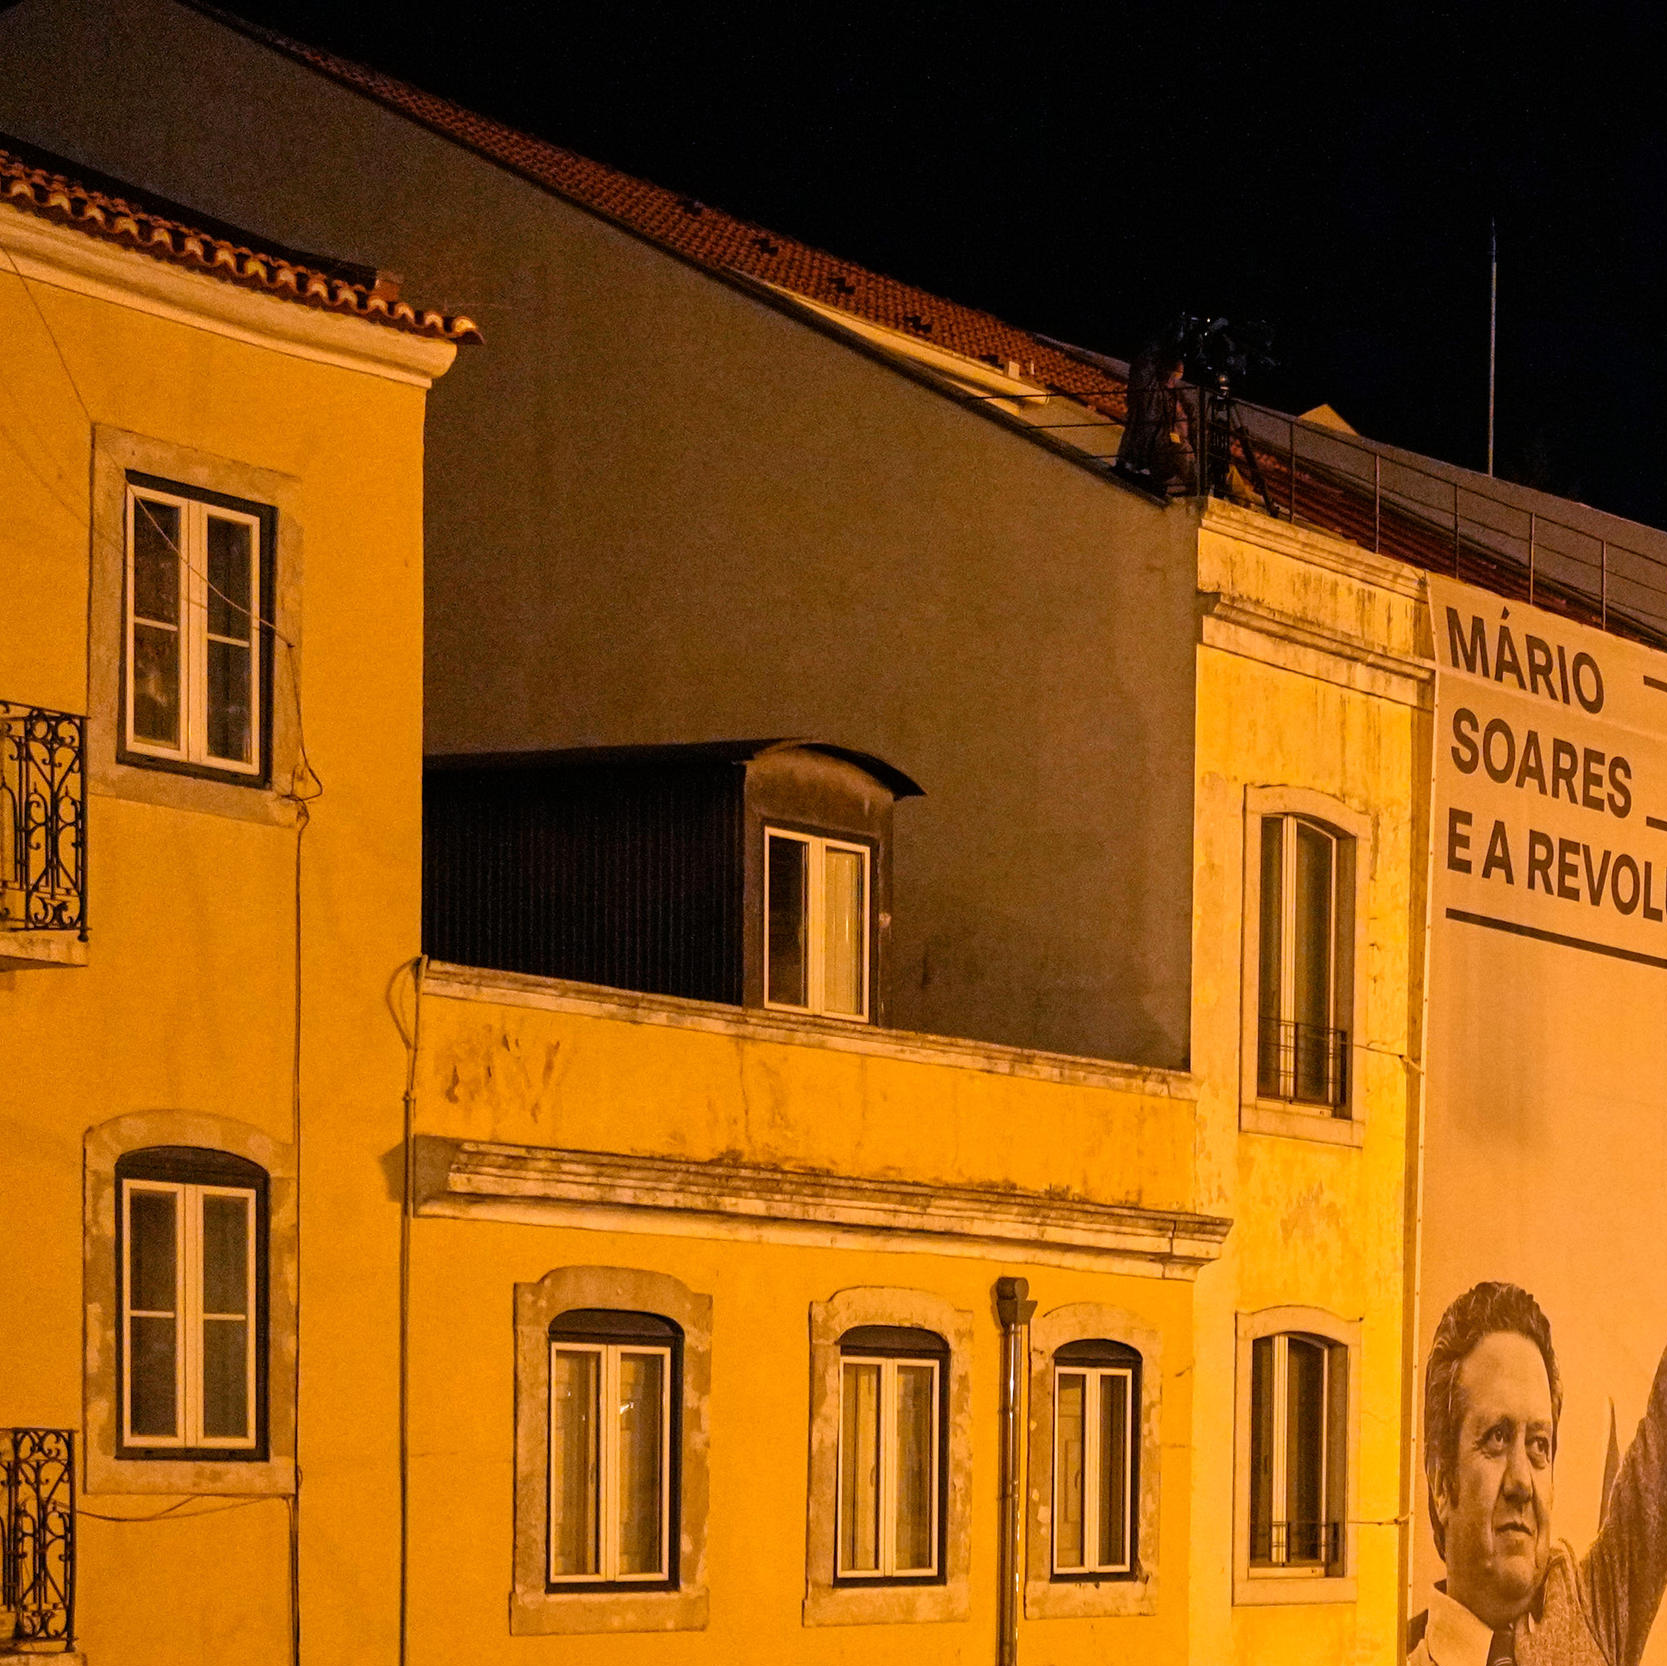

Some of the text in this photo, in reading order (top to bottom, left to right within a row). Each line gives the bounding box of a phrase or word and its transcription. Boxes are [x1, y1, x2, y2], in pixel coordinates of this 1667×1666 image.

[1446, 606, 1604, 714] MÁRIO
[1451, 708, 1632, 818] SOARES
[1447, 807, 1473, 875] E
[1481, 820, 1515, 885] A
